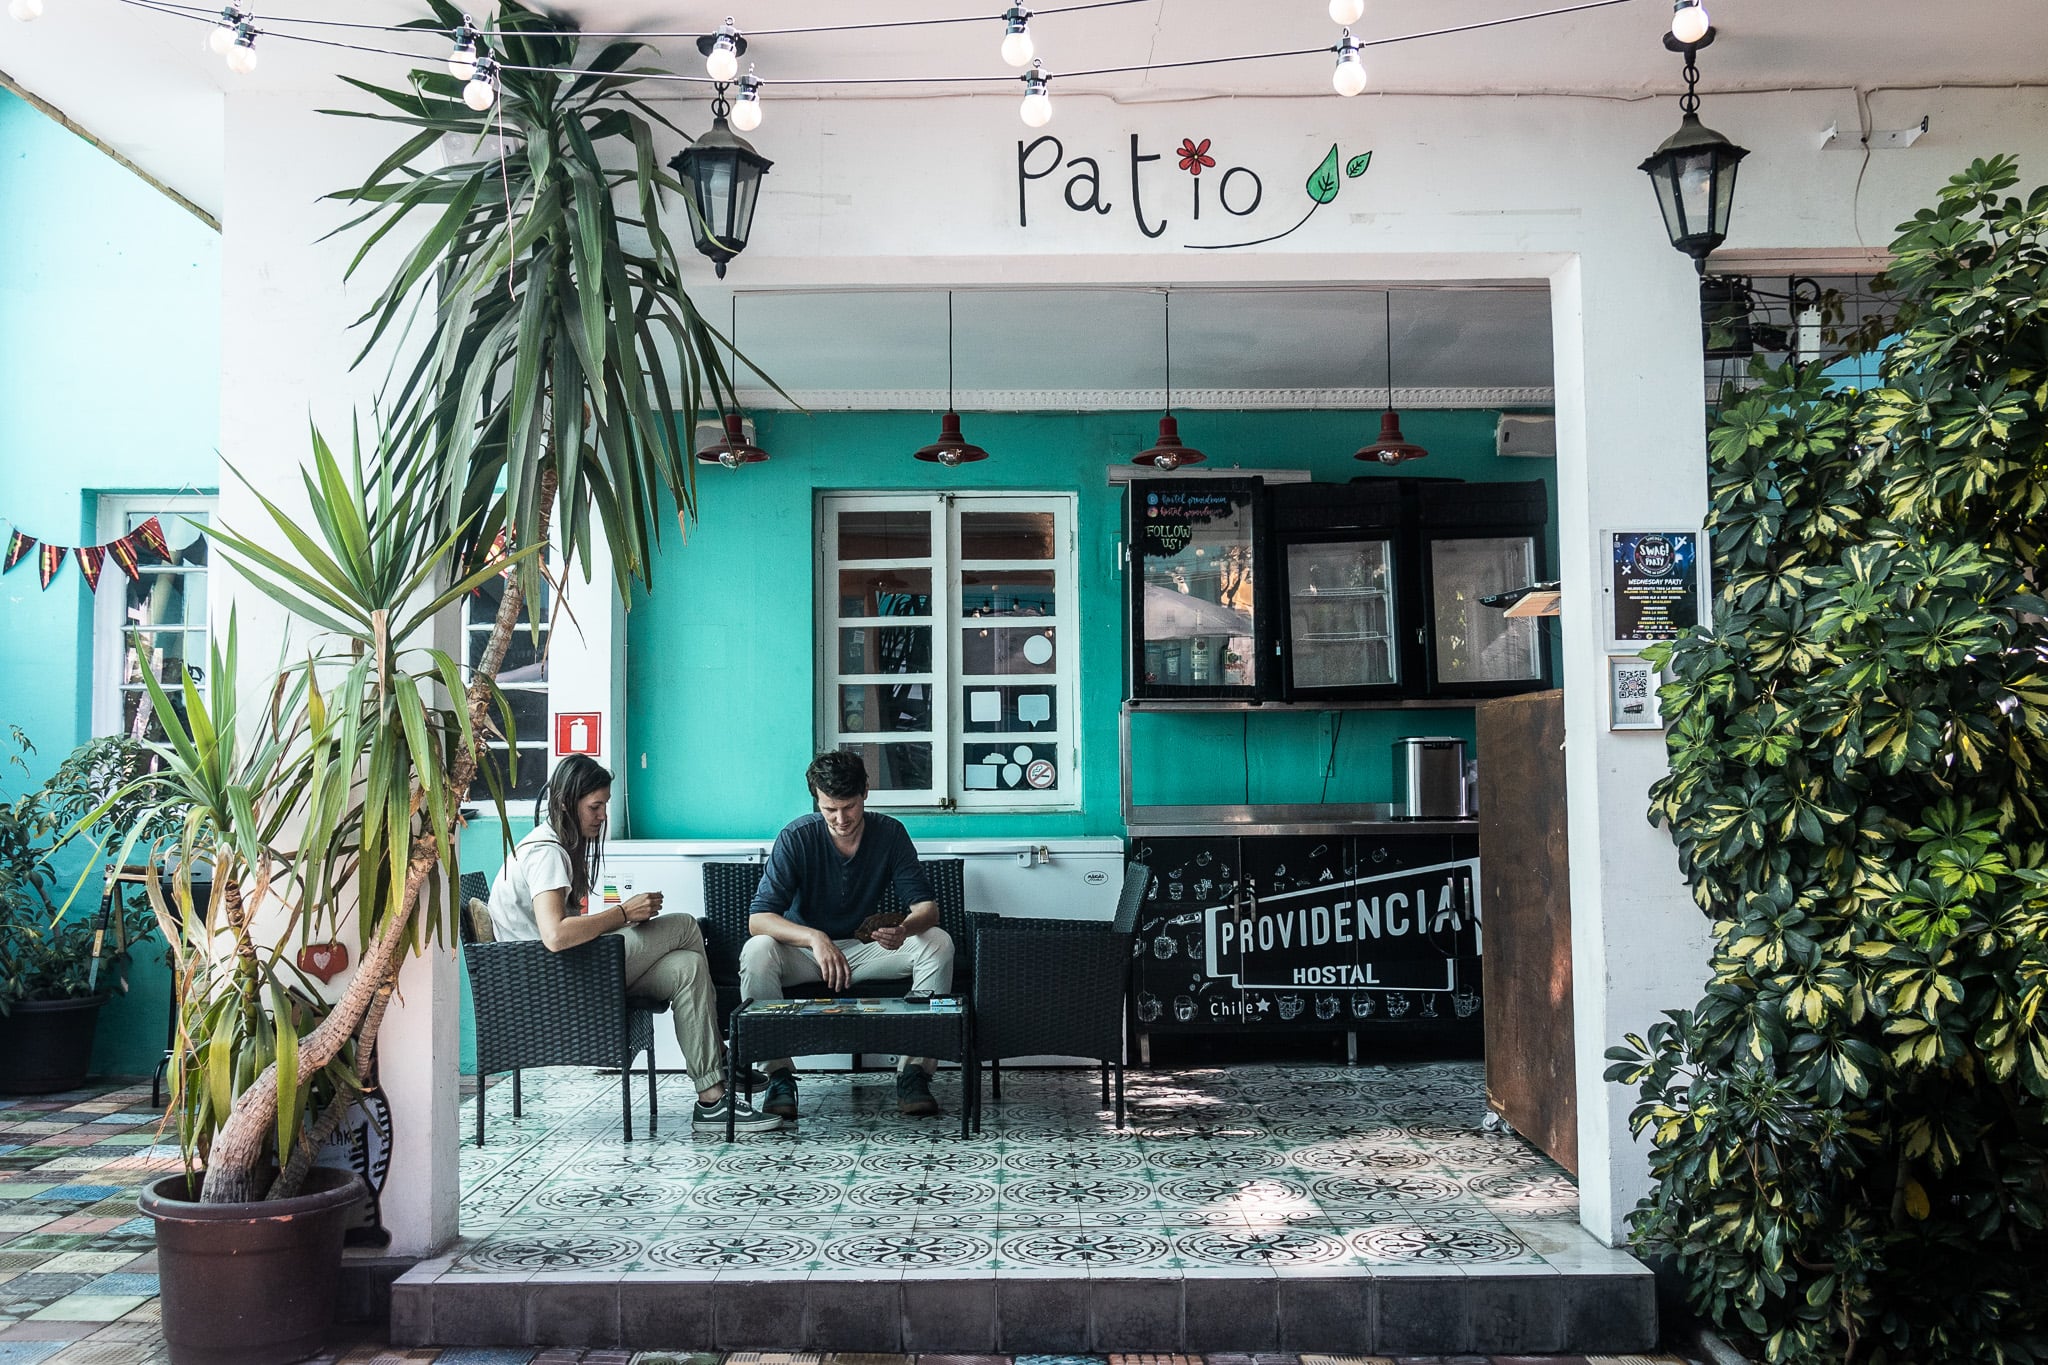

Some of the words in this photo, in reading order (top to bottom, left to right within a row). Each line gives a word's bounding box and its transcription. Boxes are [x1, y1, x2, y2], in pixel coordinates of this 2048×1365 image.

[1017, 133, 1263, 238] Patio
[1145, 525, 1191, 538] FOLLOW
[1639, 543, 1669, 557] SWAG!
[1645, 557, 1664, 567] PARTY
[1222, 885, 1462, 955] PROVIDENCIA
[1293, 963, 1380, 985] HOSTAL
[1210, 1001, 1254, 1016] Chile
